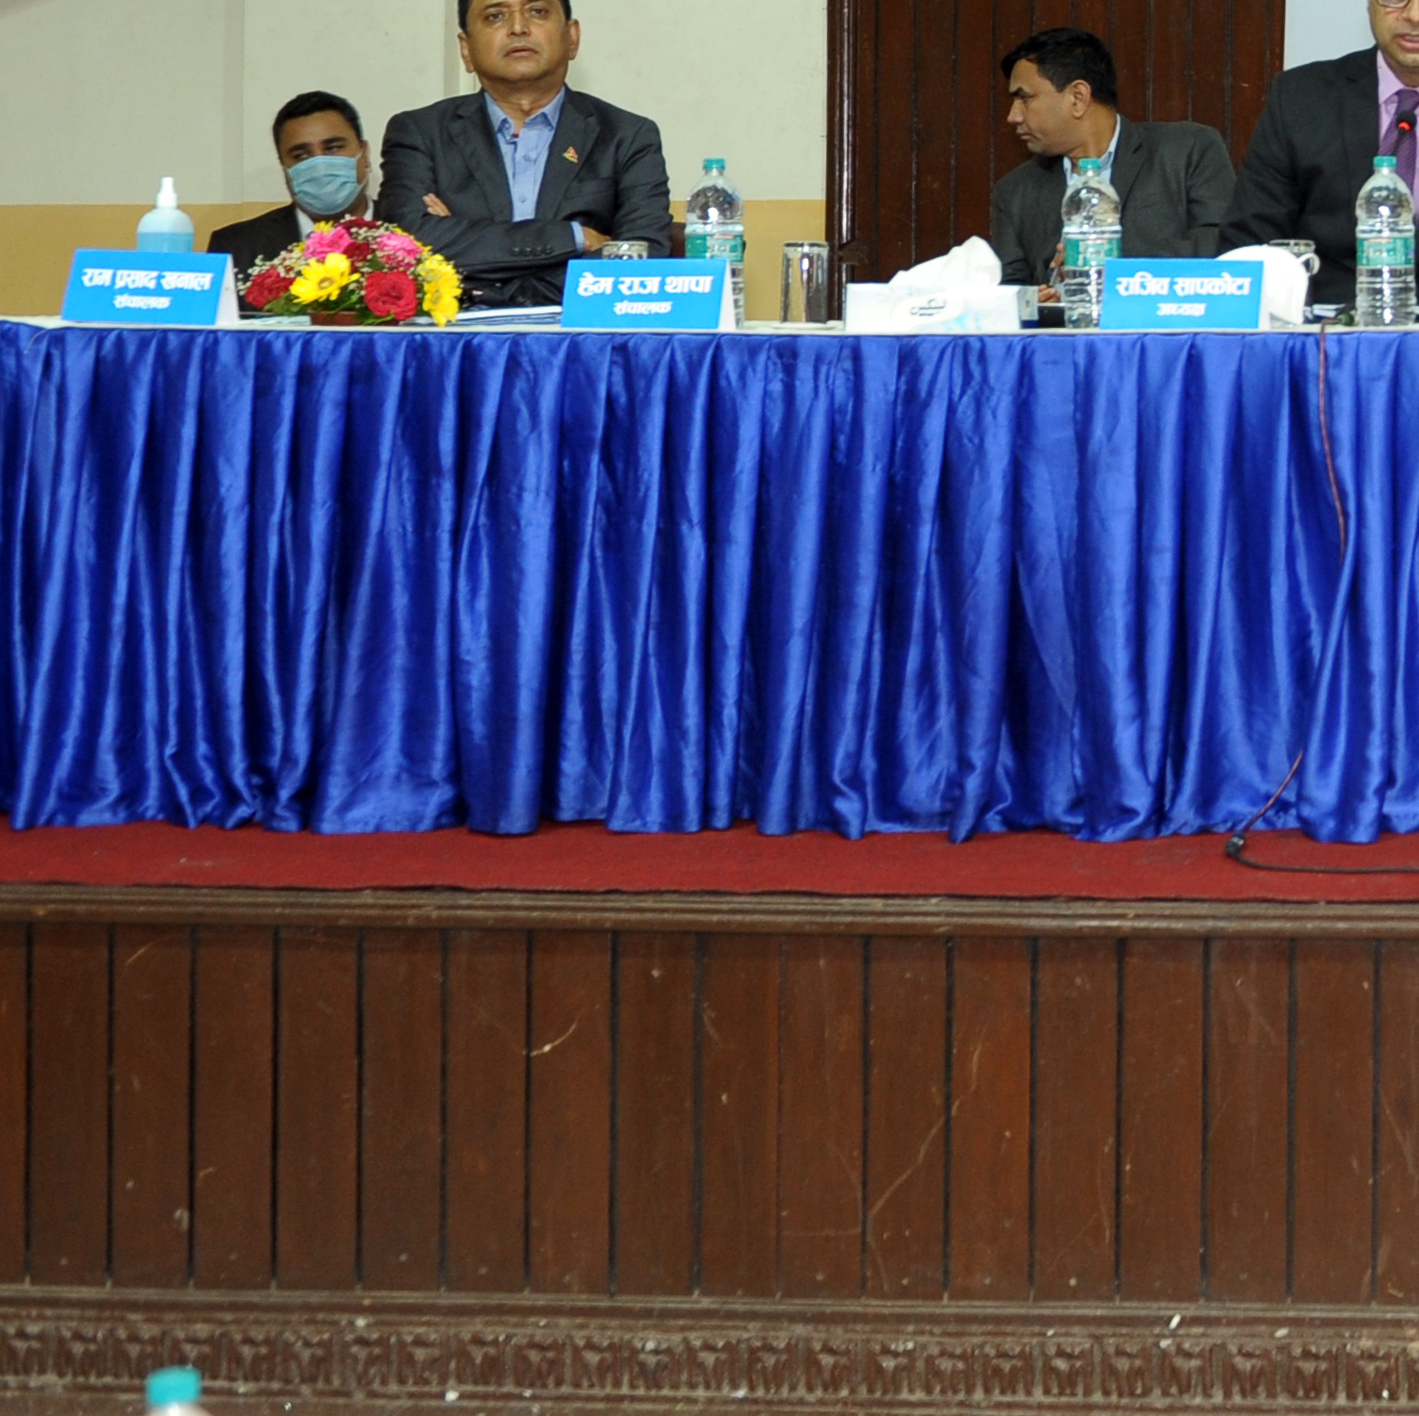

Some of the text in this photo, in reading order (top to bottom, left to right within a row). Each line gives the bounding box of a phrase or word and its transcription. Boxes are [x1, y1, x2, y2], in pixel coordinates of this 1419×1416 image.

[81, 268, 115, 288] राम
[577, 272, 714, 297] हेम राज थापा
[1115, 271, 1252, 297] राजिव सापकोटा
